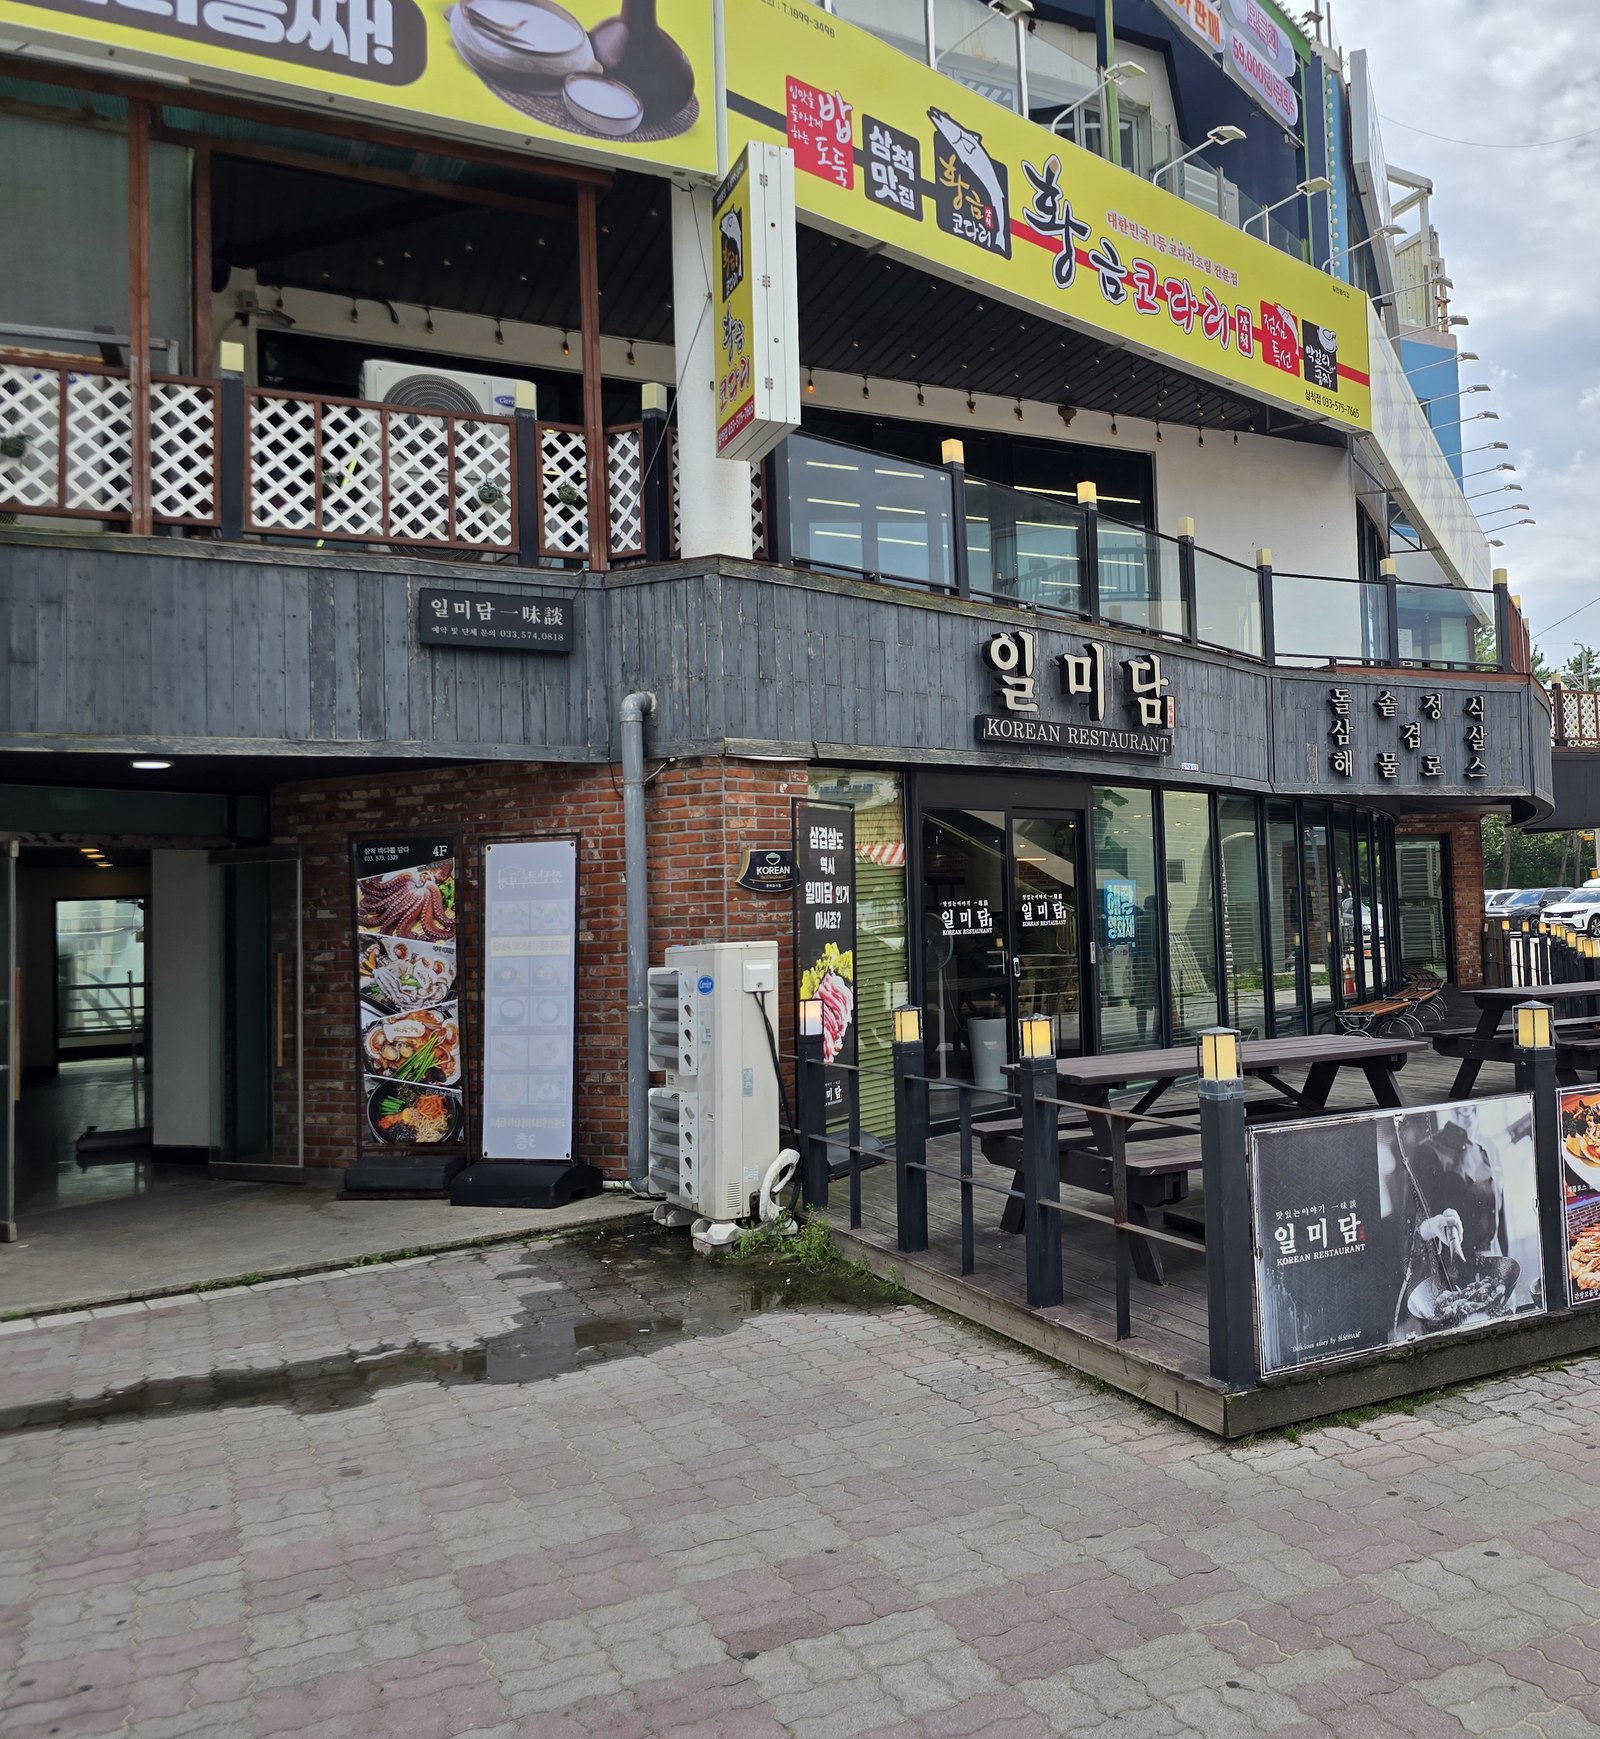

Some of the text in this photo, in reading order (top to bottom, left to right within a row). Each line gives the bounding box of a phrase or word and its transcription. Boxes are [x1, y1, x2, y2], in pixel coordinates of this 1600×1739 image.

[789, 85, 815, 110] 입맛을
[790, 104, 824, 131] 돌아오게
[817, 91, 854, 144] 밥
[791, 125, 810, 145] 하는
[815, 136, 848, 188] 도둑
[869, 125, 915, 181] 삼척
[871, 162, 916, 211] 맛집
[1106, 211, 1240, 287] 대한민국 1등 코다리조림 전문점
[1305, 389, 1360, 419] 삼척점 033-575-7665
[430, 598, 564, 626] 일미담 一味談
[431, 625, 564, 641] 예약 및 단체 문의 033.574.0818
[984, 630, 1169, 727] 일미담
[987, 718, 1169, 754] KOREAN RESTAURANT
[809, 826, 844, 850] 삼겹살도
[433, 845, 448, 857] 4F
[756, 866, 791, 875] KOREAN
[820, 856, 835, 875] 역시
[805, 881, 849, 904] 일미담 인기
[815, 911, 841, 930] 아시죠?
[941, 907, 991, 929] 일미담
[1021, 901, 1065, 920] 일미담
[1275, 1204, 1325, 1220] 맛있는이야기
[1274, 1212, 1361, 1255] 일미담
[1276, 1243, 1366, 1267] KOREAN RESTAURANT
